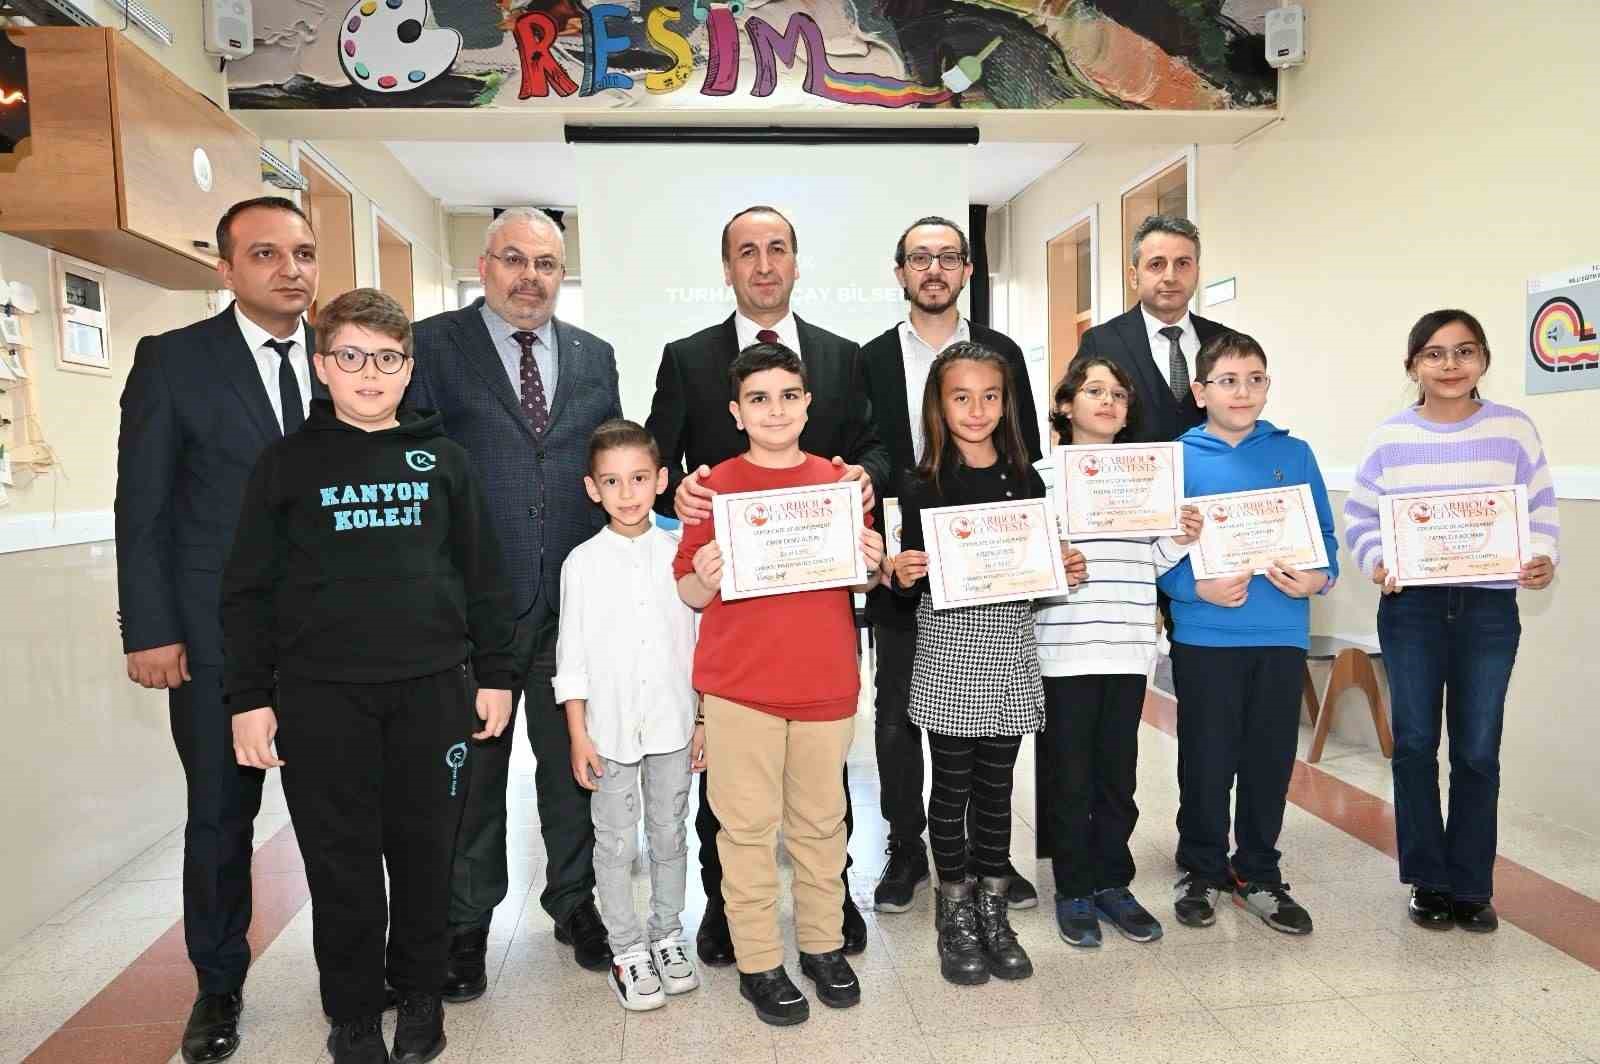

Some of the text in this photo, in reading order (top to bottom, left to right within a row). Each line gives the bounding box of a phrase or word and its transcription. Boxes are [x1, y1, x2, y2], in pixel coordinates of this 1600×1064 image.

[664, 287, 736, 304] TURHA
[836, 280, 903, 304] BİLSE
[320, 481, 429, 506] KANYON
[334, 501, 422, 531] KOLEJİ
